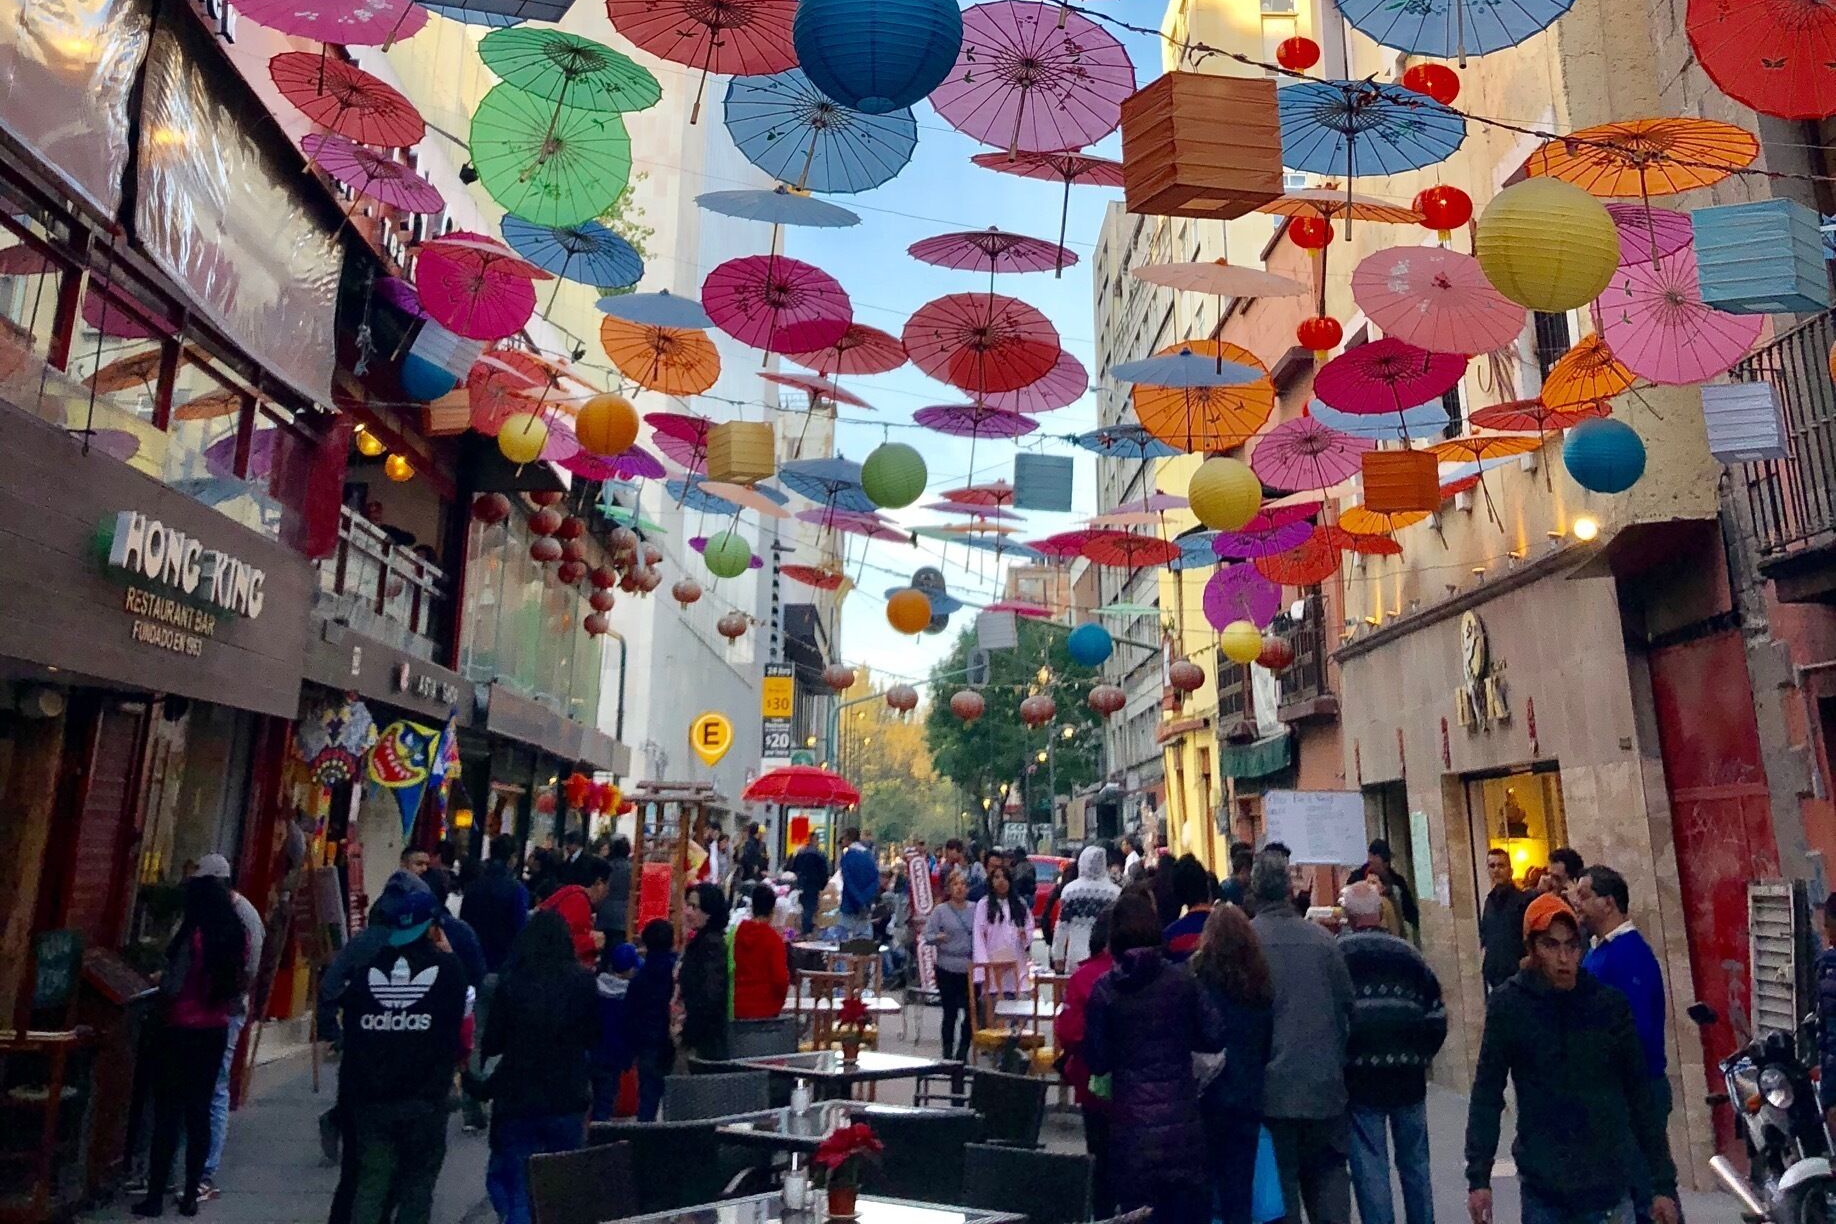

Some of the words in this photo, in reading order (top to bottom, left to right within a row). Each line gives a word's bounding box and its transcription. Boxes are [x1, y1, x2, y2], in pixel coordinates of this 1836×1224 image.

[115, 511, 204, 594] HONG
[207, 550, 266, 619] KING
[126, 586, 195, 631] RESTAURANT
[194, 609, 216, 636] BAR
[767, 697, 789, 710] $30
[704, 722, 720, 745] E
[765, 733, 789, 748] $20
[361, 1010, 432, 1031] adidas
